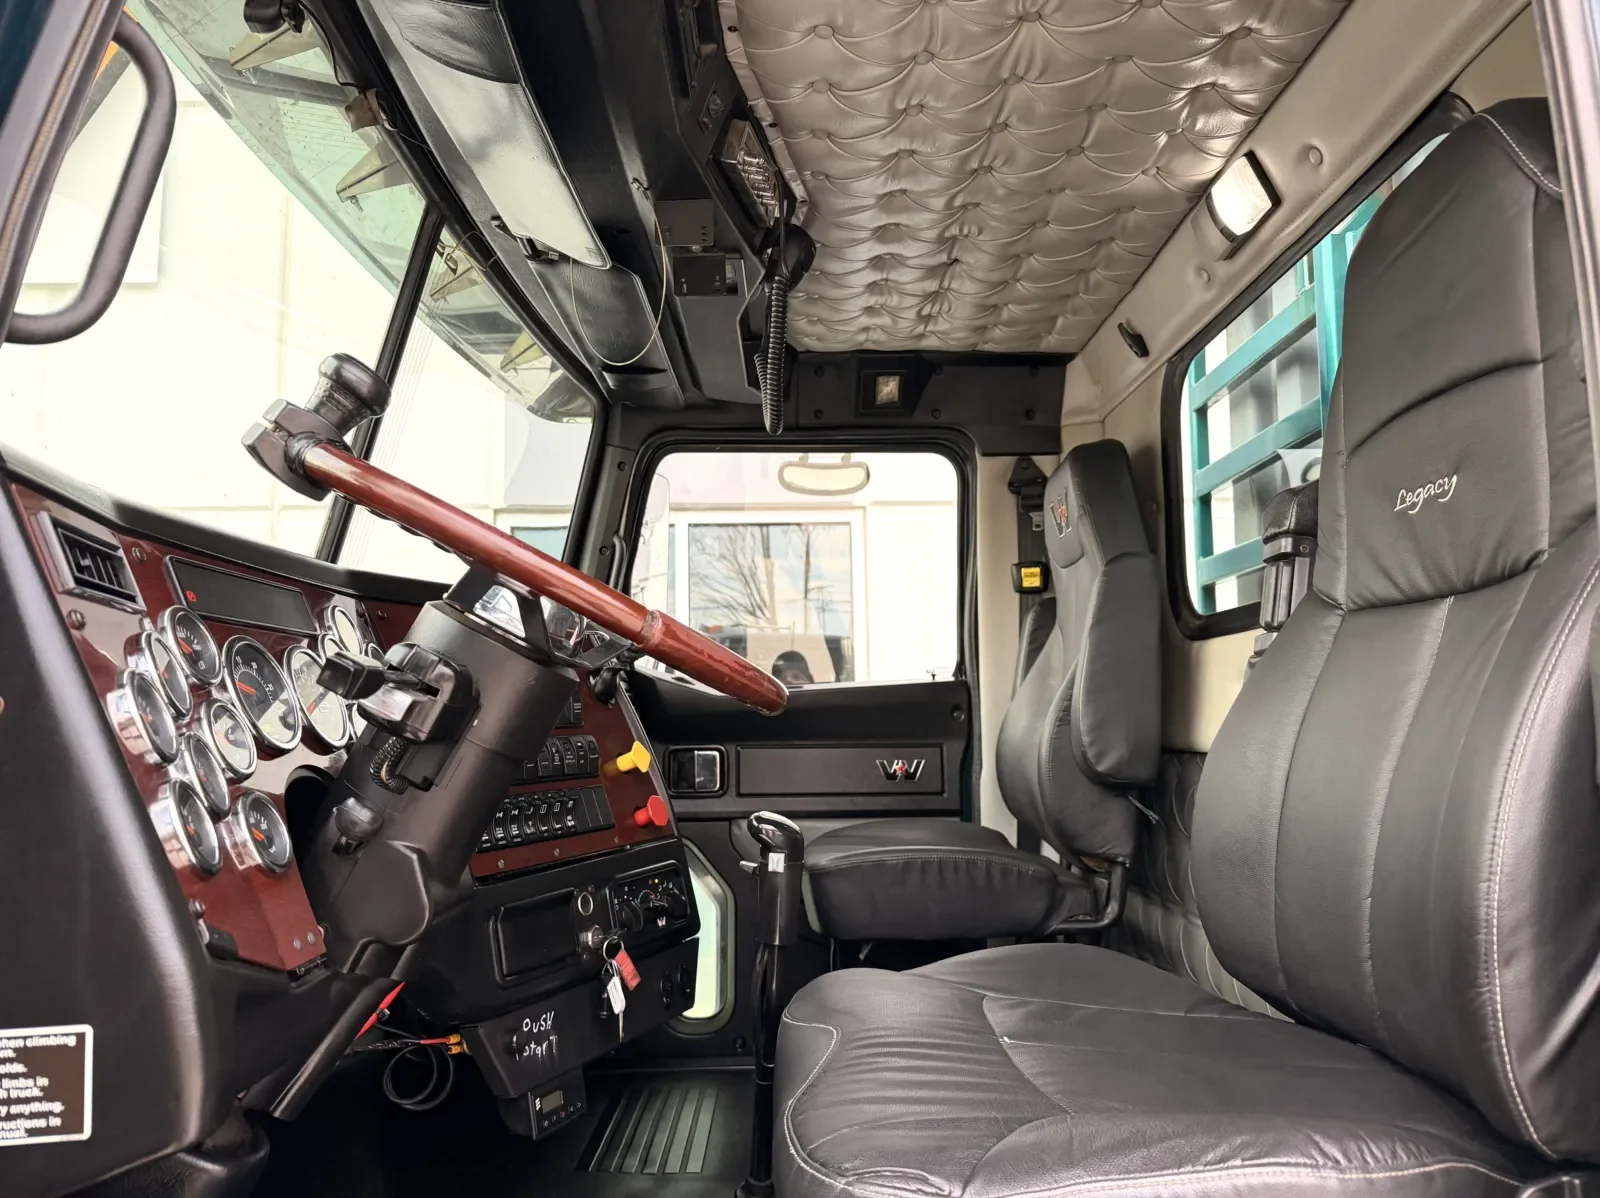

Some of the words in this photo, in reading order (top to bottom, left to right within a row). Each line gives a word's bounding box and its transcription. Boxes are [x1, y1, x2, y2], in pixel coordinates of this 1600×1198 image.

[1393, 474, 1457, 514] Legacy
[0, 1038, 24, 1049] hen
[26, 1035, 77, 1047] climbing
[36, 1076, 49, 1087] in
[49, 1116, 62, 1127] in
